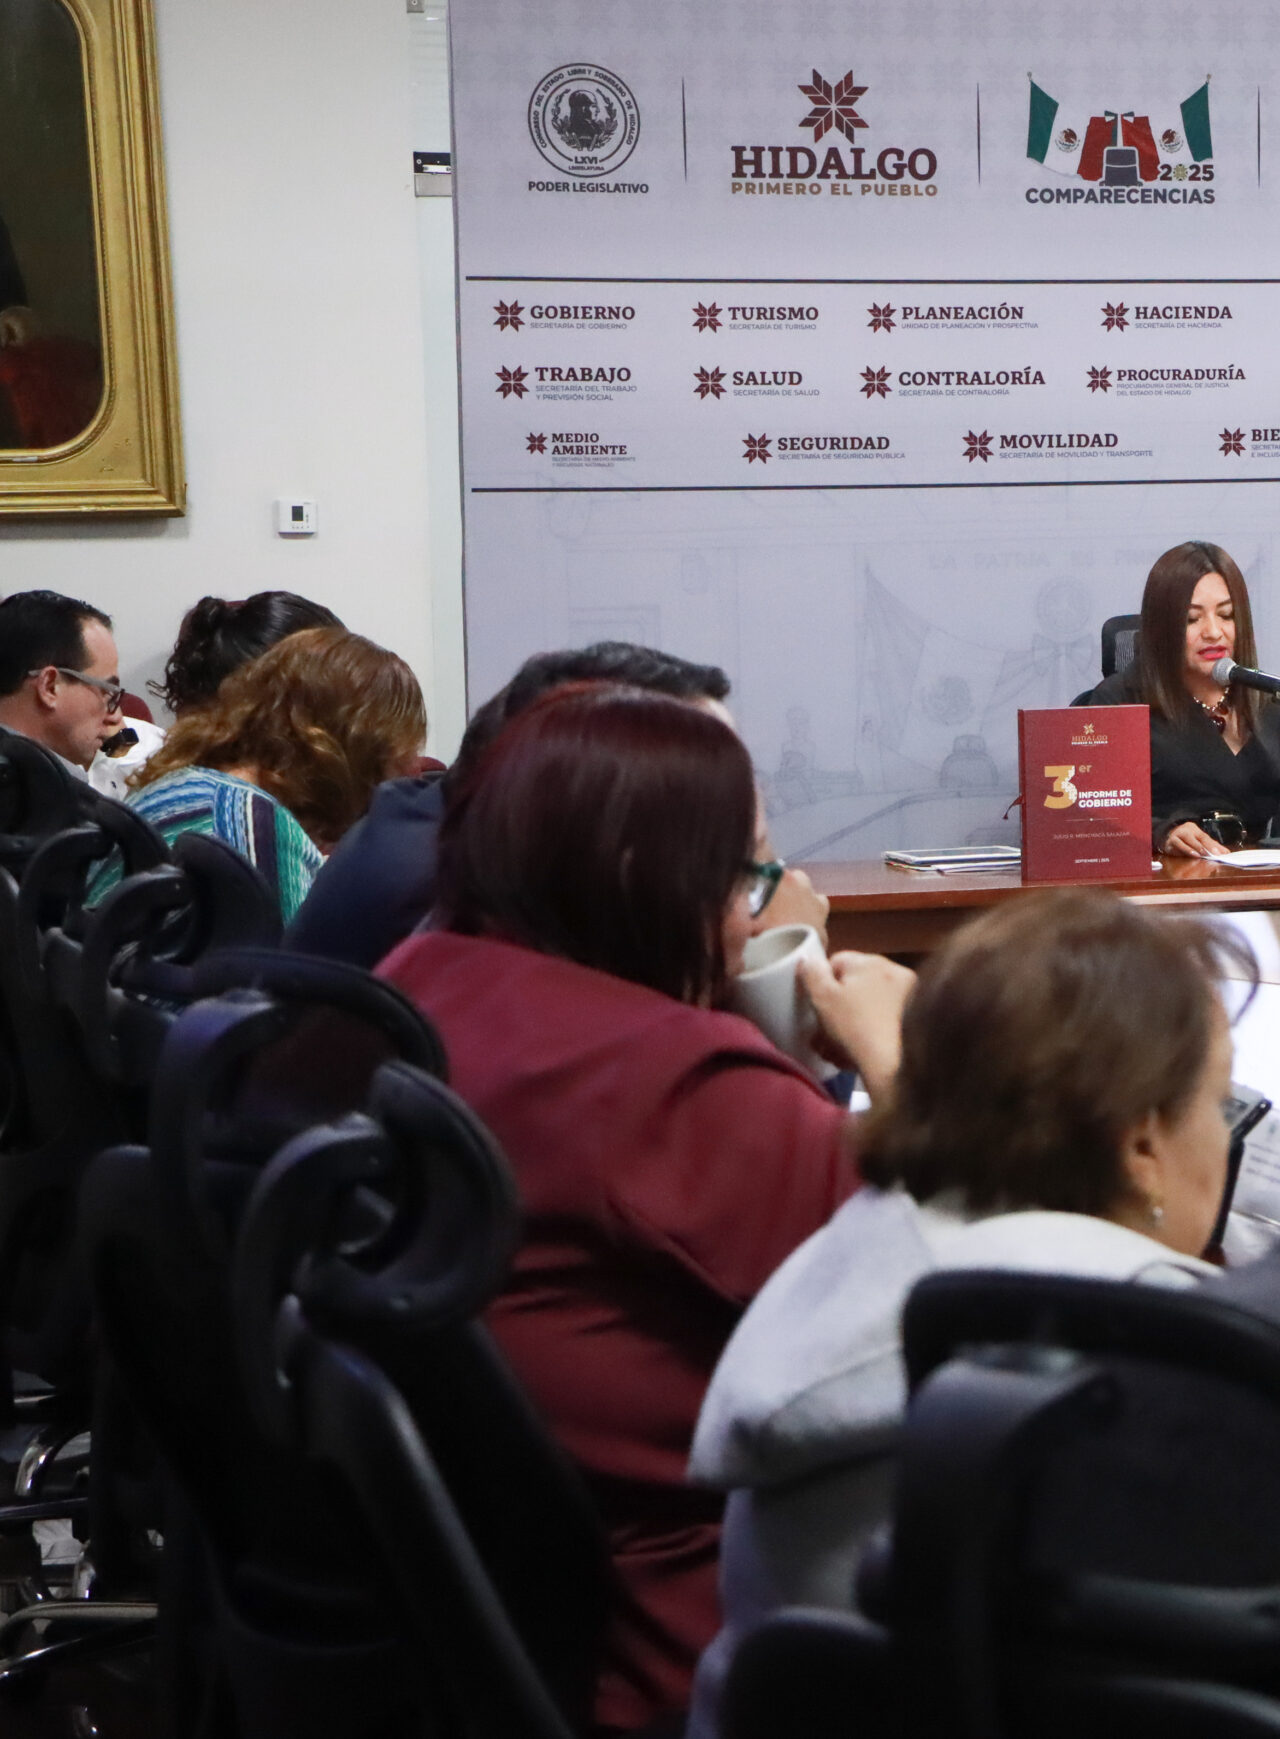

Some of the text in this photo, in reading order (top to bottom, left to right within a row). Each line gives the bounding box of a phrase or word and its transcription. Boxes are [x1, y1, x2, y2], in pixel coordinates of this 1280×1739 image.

[542, 73, 564, 93] ESTADO
[594, 71, 626, 98] SOBERANO
[535, 95, 544, 106] DEL
[625, 100, 633, 110] DE
[626, 114, 636, 145] HIDALGO
[574, 156, 598, 164] LXVI
[730, 146, 938, 182] HIDALGO
[528, 182, 649, 194] PODER LEGISLATIVO
[731, 182, 938, 198] PRIMERO EL PUEBLO
[1025, 188, 1216, 204] COMPARECENCIAS
[530, 305, 635, 320] GOBIERNO
[728, 306, 818, 321] TURISMO
[902, 302, 1024, 320] PLANEACIÓN
[1134, 306, 1233, 320] HACIENDA
[535, 367, 632, 383] TRABAJO
[732, 371, 803, 386] SALUD
[898, 366, 1046, 386] CONTRALORÍA
[1117, 364, 1246, 381] PROCURADURÍA
[552, 433, 600, 442] MEDIO
[778, 436, 890, 451] SEGURIDAD
[1000, 433, 1118, 449] MOVILIDAD
[552, 445, 627, 455] AMBIENTE
[1078, 790, 1118, 798] INFORME
[1078, 798, 1132, 808] GOBIERNO
